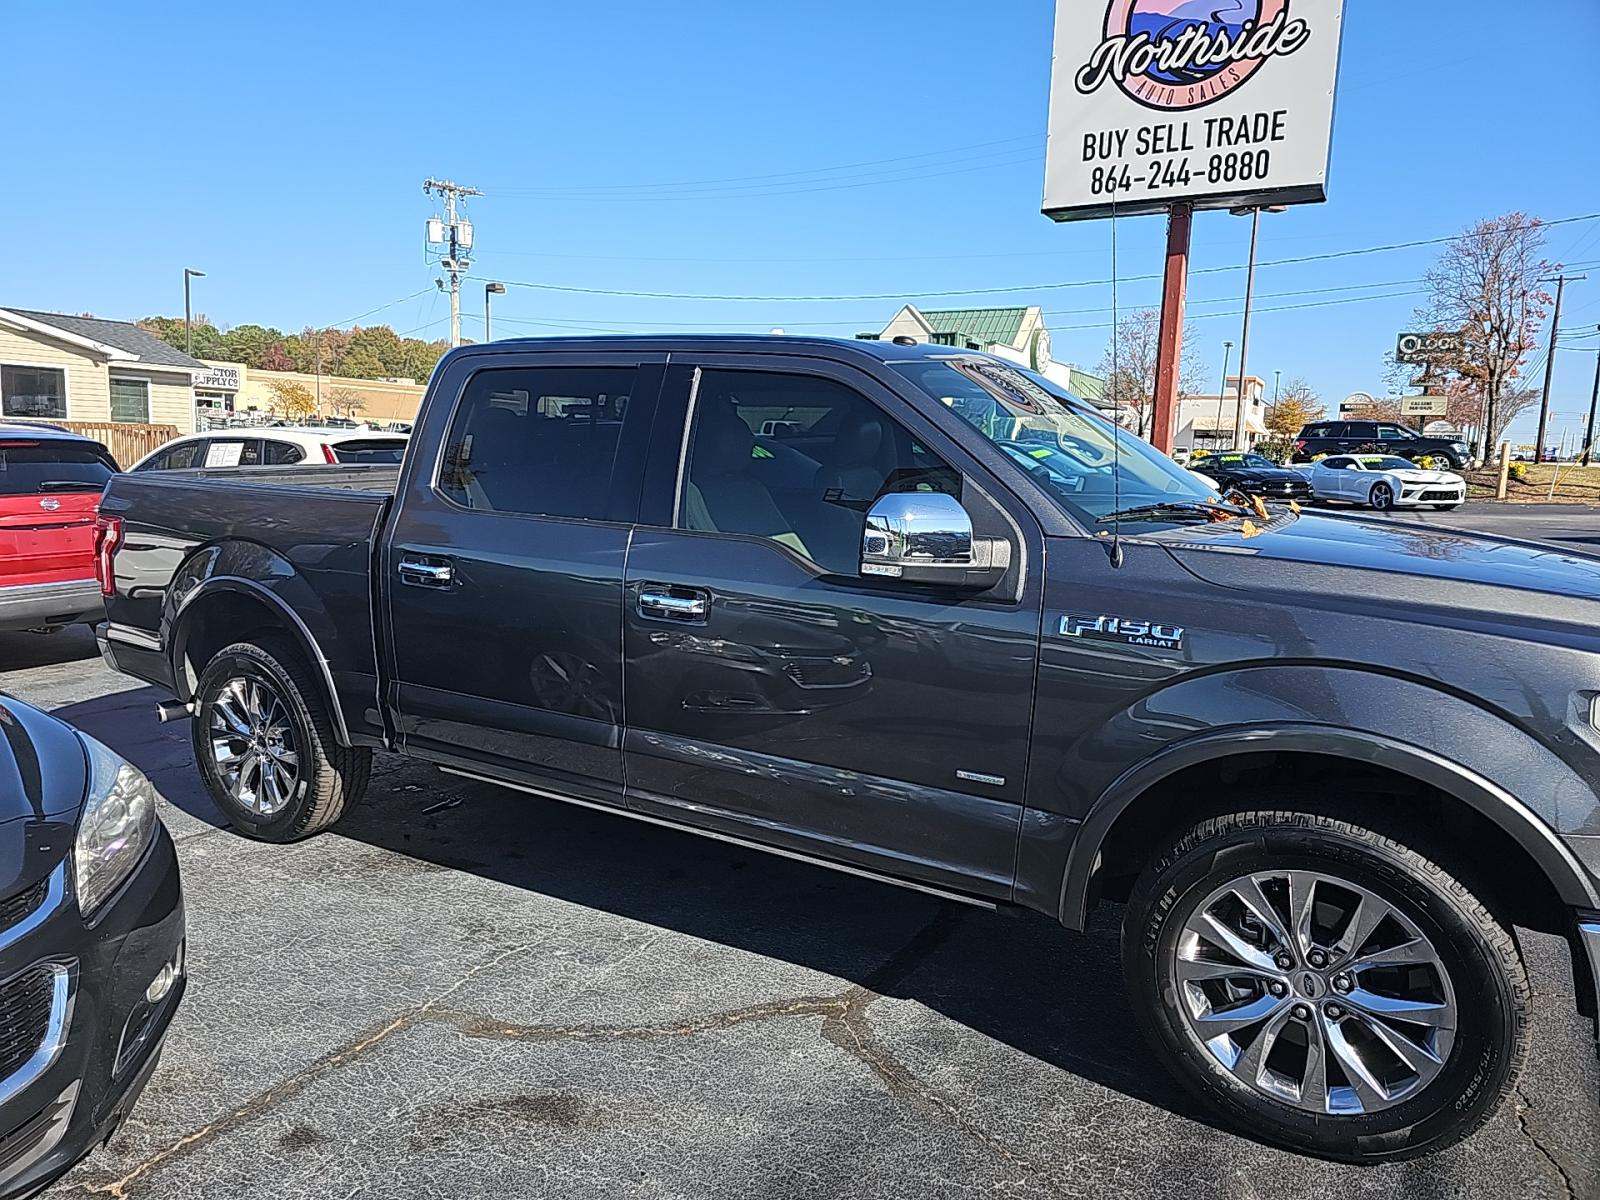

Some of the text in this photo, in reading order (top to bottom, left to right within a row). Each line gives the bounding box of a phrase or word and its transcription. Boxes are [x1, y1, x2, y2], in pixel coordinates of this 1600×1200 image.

[1076, 11, 1310, 93] Northside
[1134, 67, 1243, 105] AUTO SALES
[1082, 110, 1287, 161] BUY SELL TRADE
[1091, 150, 1270, 195] 864-244-8880
[1128, 636, 1174, 648] LARIAT
